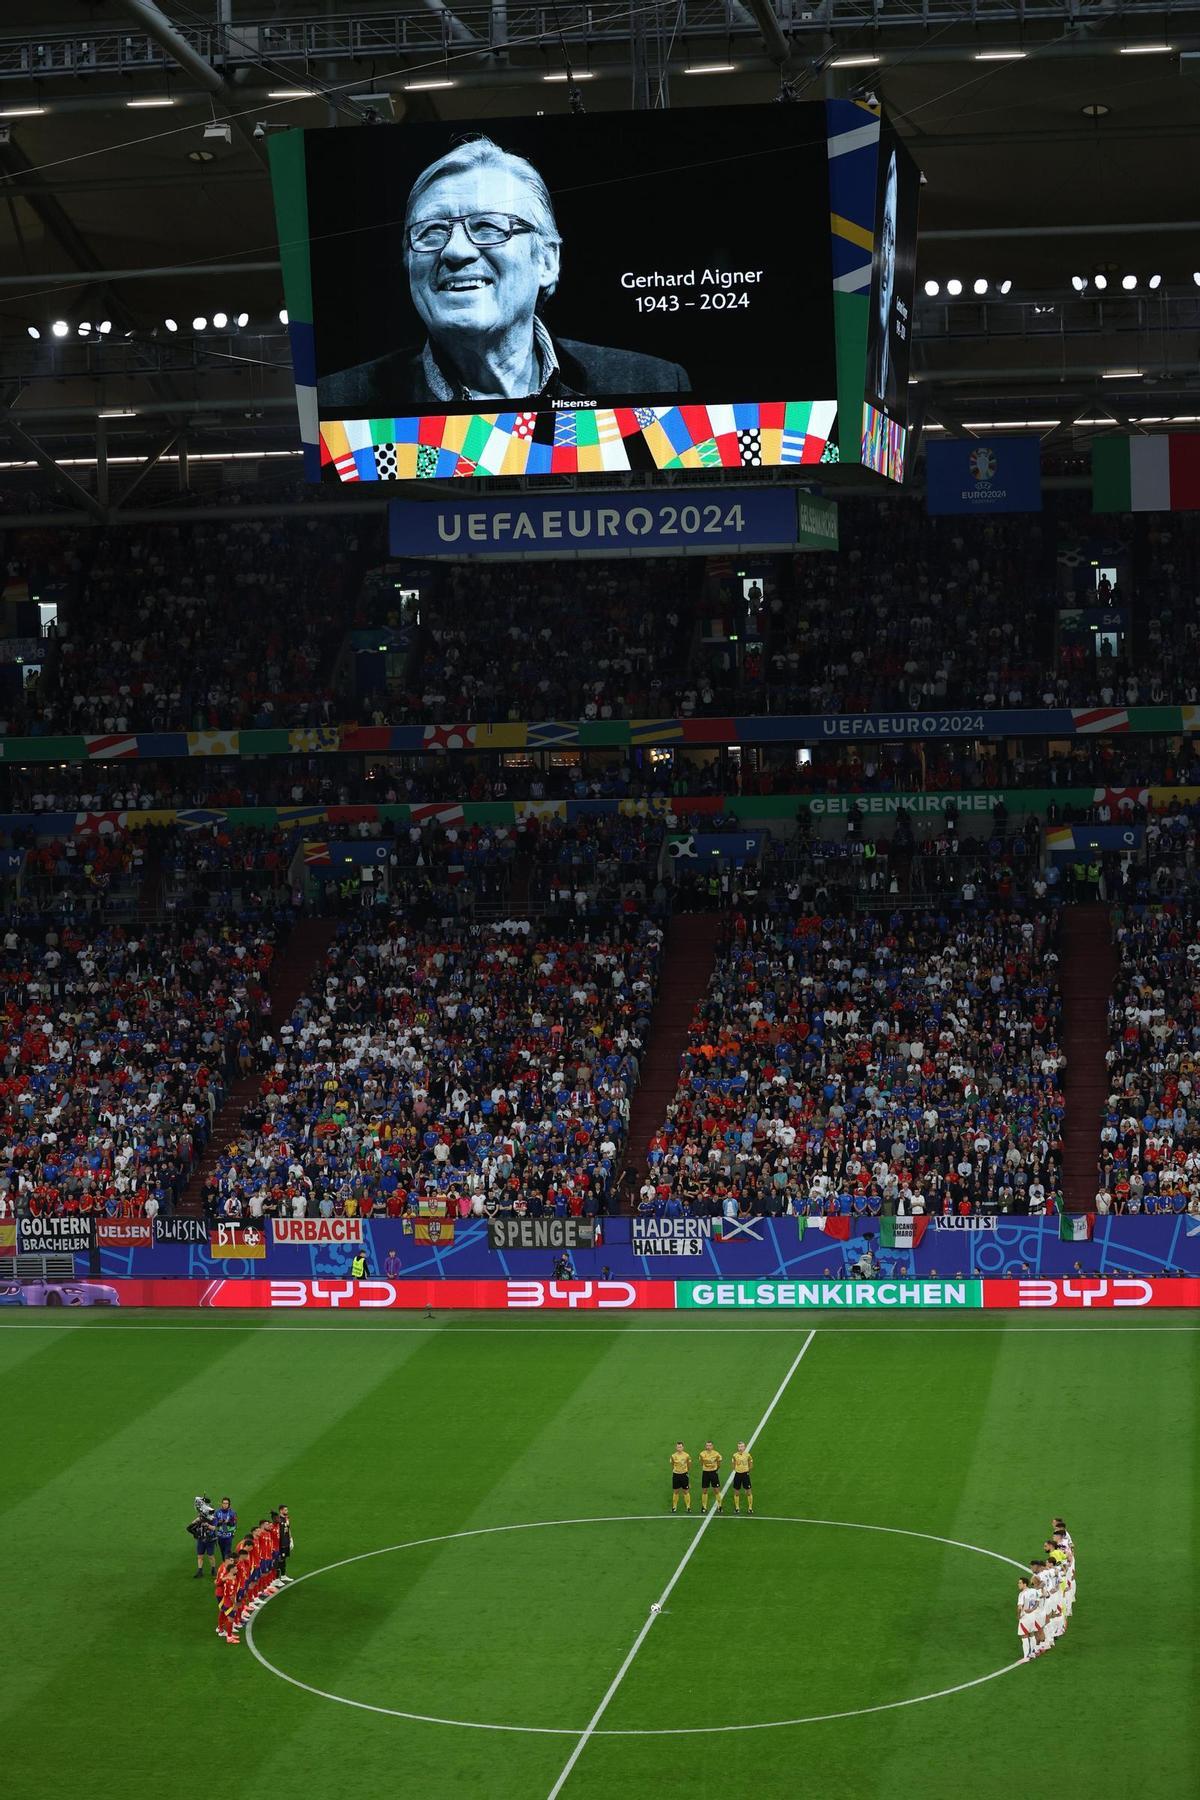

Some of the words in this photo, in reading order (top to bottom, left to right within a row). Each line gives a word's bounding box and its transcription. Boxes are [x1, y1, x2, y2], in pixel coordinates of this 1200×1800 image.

[620, 270, 695, 289] Gerhard
[700, 268, 764, 289] Aigner
[635, 294, 680, 312] 1943
[700, 291, 750, 310] 2024
[551, 399, 598, 409] Hisense
[1103, 614, 1121, 625] 54
[745, 839, 755, 851] P
[1123, 831, 1135, 845] Q
[21, 1217, 91, 1236] GOLTERN
[98, 1225, 151, 1239] UELSEN
[217, 1221, 241, 1250] BT
[274, 1219, 361, 1241] URBACH
[493, 1220, 577, 1247] SPENGE
[633, 1218, 711, 1238] HADERN
[22, 1237, 90, 1251] BRACHELEN
[634, 1239, 678, 1255] HALLE
[270, 1281, 397, 1307] BYD
[506, 1281, 637, 1308] BYD
[692, 1283, 966, 1305] GELSENKIRCHEN
[1018, 1280, 1154, 1307] BYD
